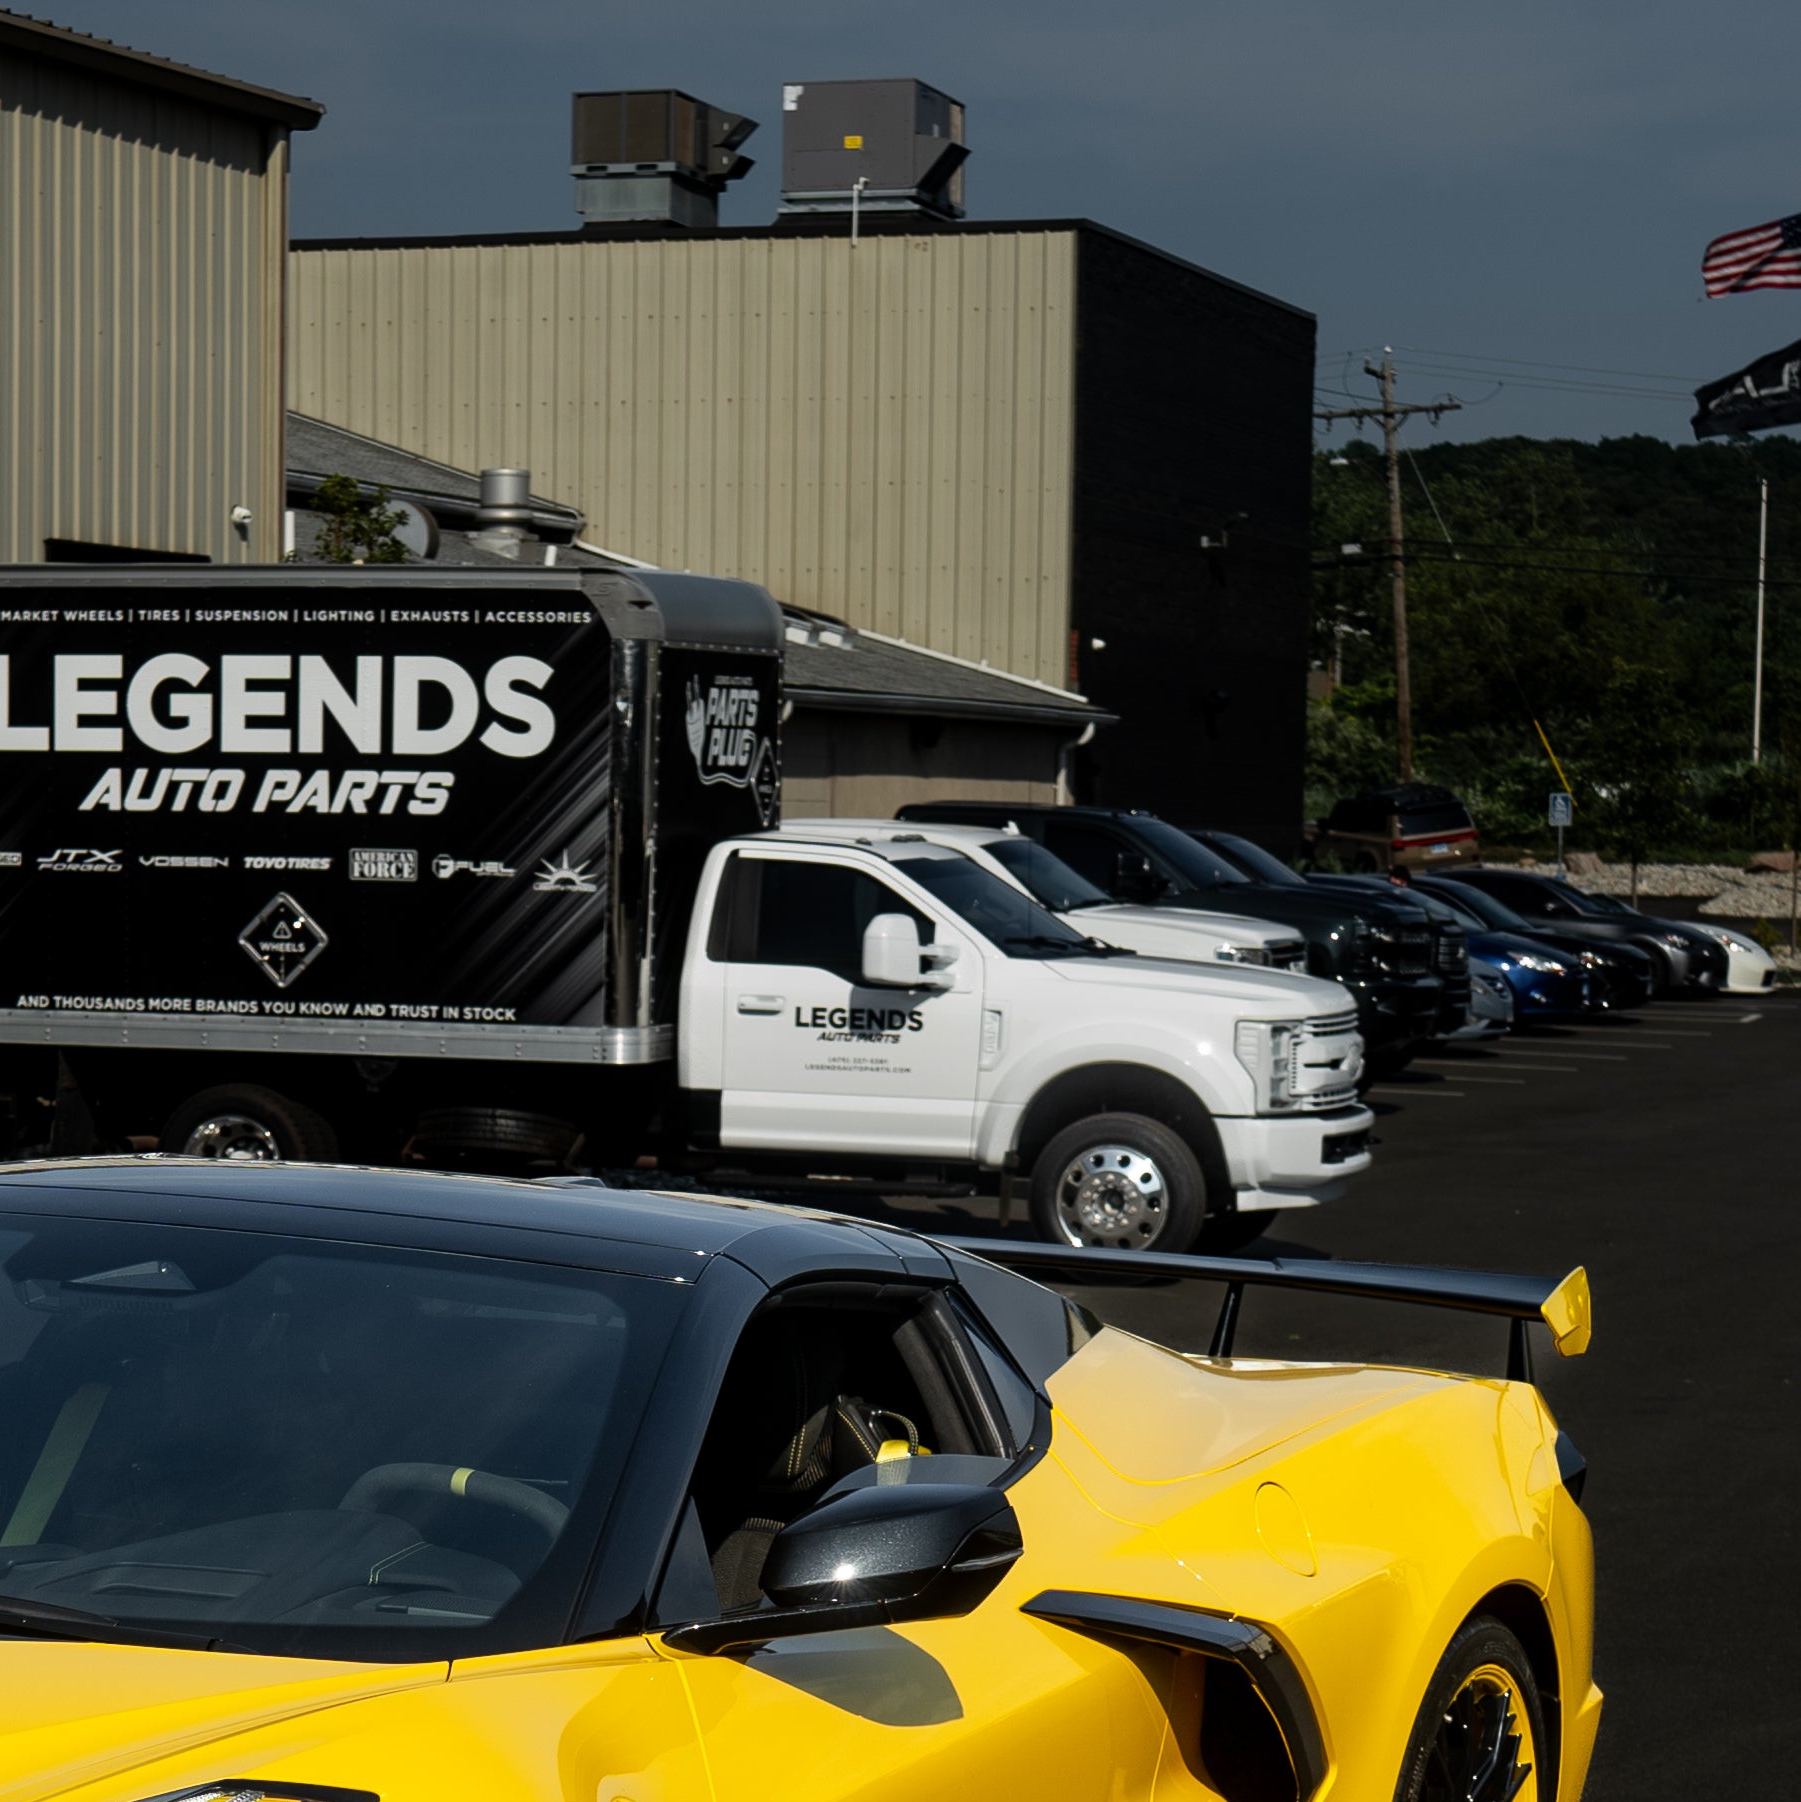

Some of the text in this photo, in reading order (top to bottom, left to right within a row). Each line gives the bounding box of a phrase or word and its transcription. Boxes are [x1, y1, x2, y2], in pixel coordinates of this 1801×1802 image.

[63, 610, 124, 622] WHEELS
[138, 609, 181, 622] TIRES
[194, 609, 288, 622] SUSPENSION
[303, 609, 375, 622] LIGHTING
[390, 610, 470, 623] EXHAUSTS
[484, 611, 592, 624] ACCESSORIES
[706, 687, 759, 727] PARTS
[78, 767, 455, 815] AUTO PARTS
[37, 848, 124, 864] JTX
[138, 855, 230, 868] VOSSEN
[353, 851, 416, 863] AMERICAN
[37, 863, 123, 873] FORGED
[353, 861, 416, 879] FORCE
[258, 941, 307, 953] WHEELS
[16, 995, 517, 1021] AND THOUSANDS MORE BRANDS YOU KNOW AND TRUST IN STOCK
[795, 1006, 924, 1032] LEGENDS
[817, 1031, 902, 1044] AUTO PARTS
